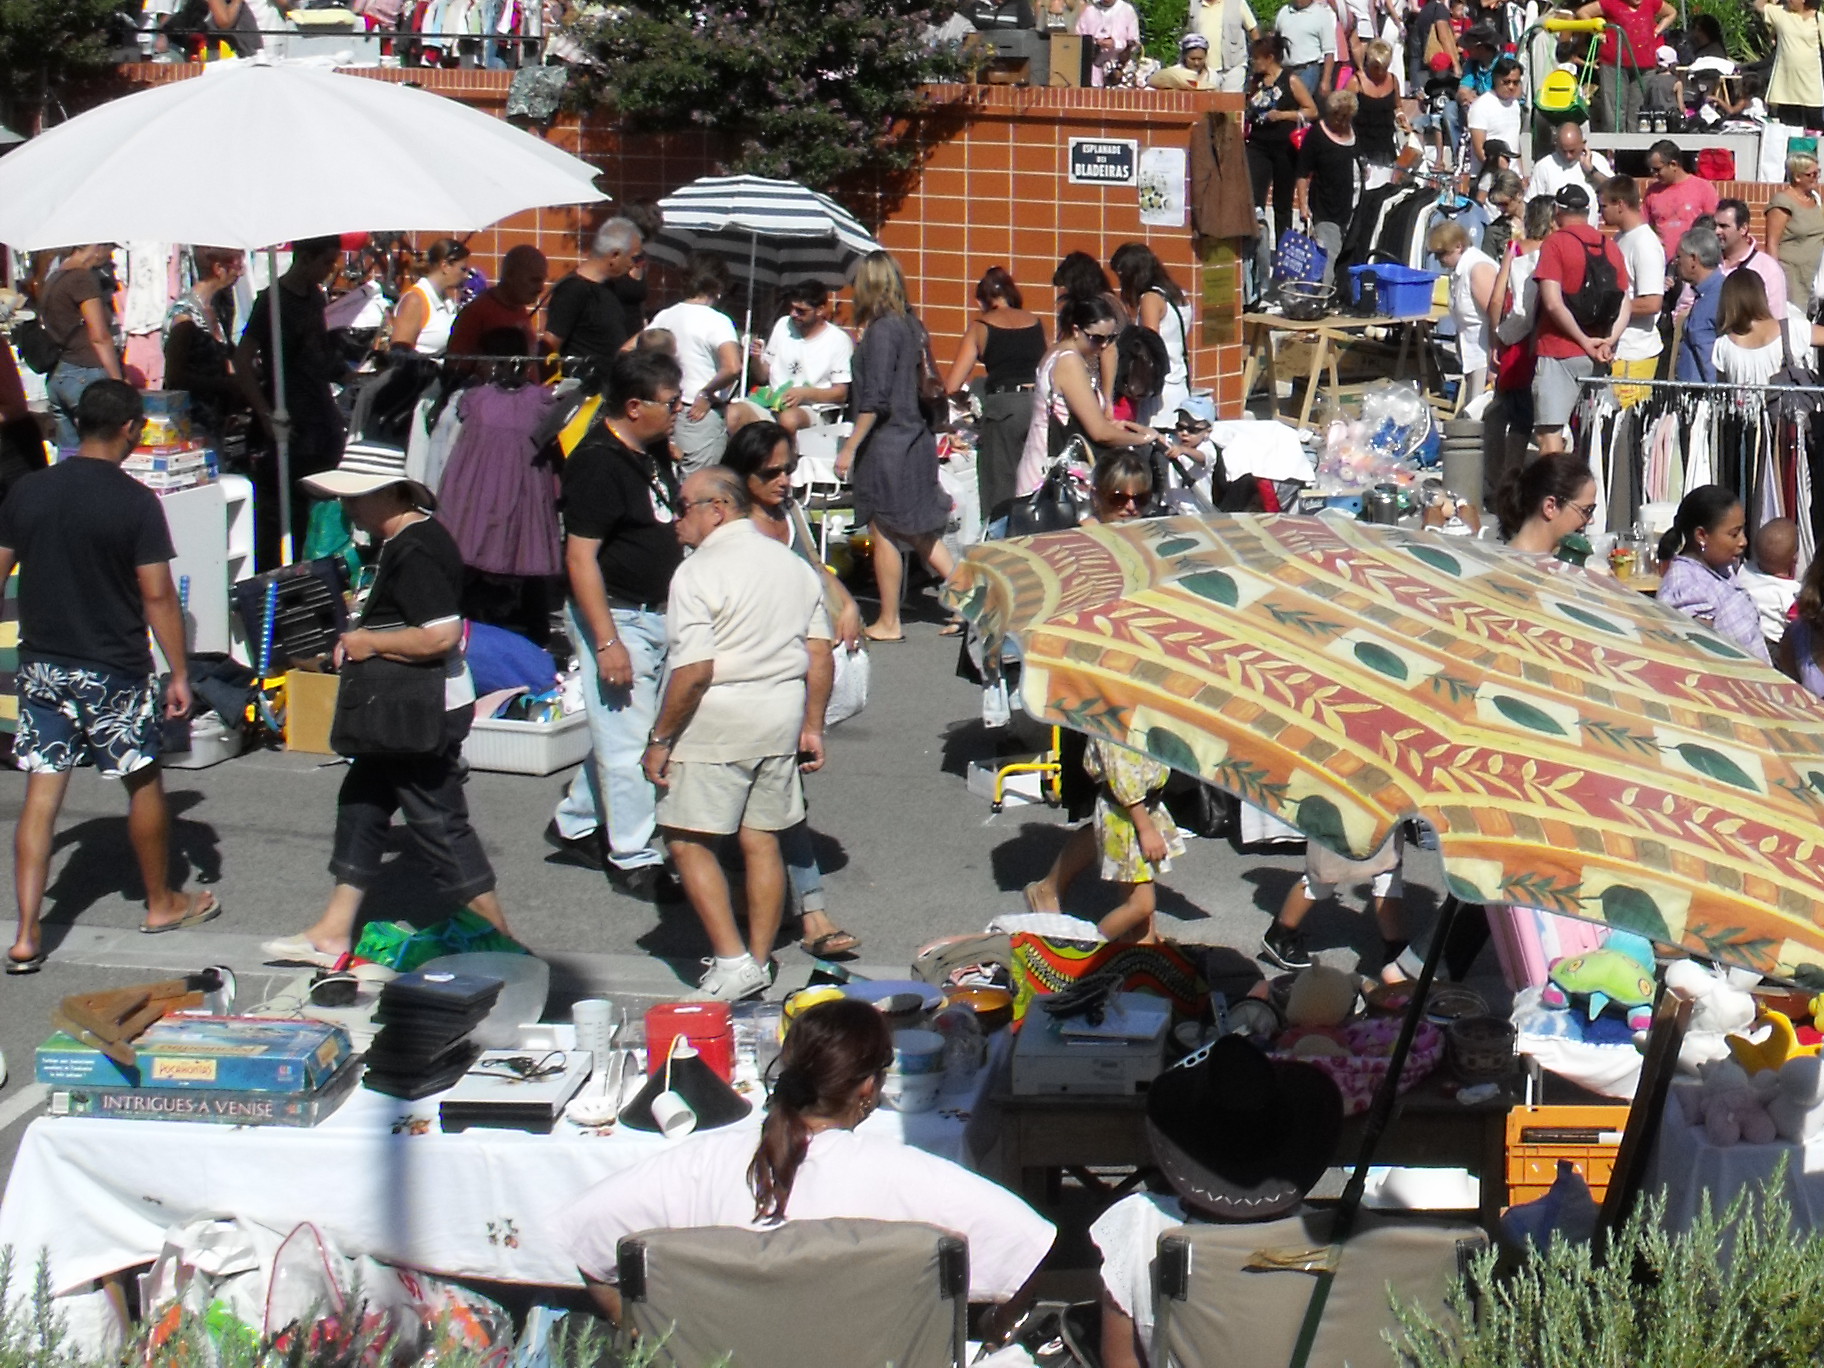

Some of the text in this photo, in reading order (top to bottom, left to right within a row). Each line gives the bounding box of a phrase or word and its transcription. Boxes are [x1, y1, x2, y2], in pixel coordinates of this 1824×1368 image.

[1082, 144, 1121, 155] ESPLANADE
[1074, 163, 1130, 179] BLADEIRAS
[103, 1094, 194, 1113] INTRIGUES
[214, 1098, 274, 1118] VENISE
